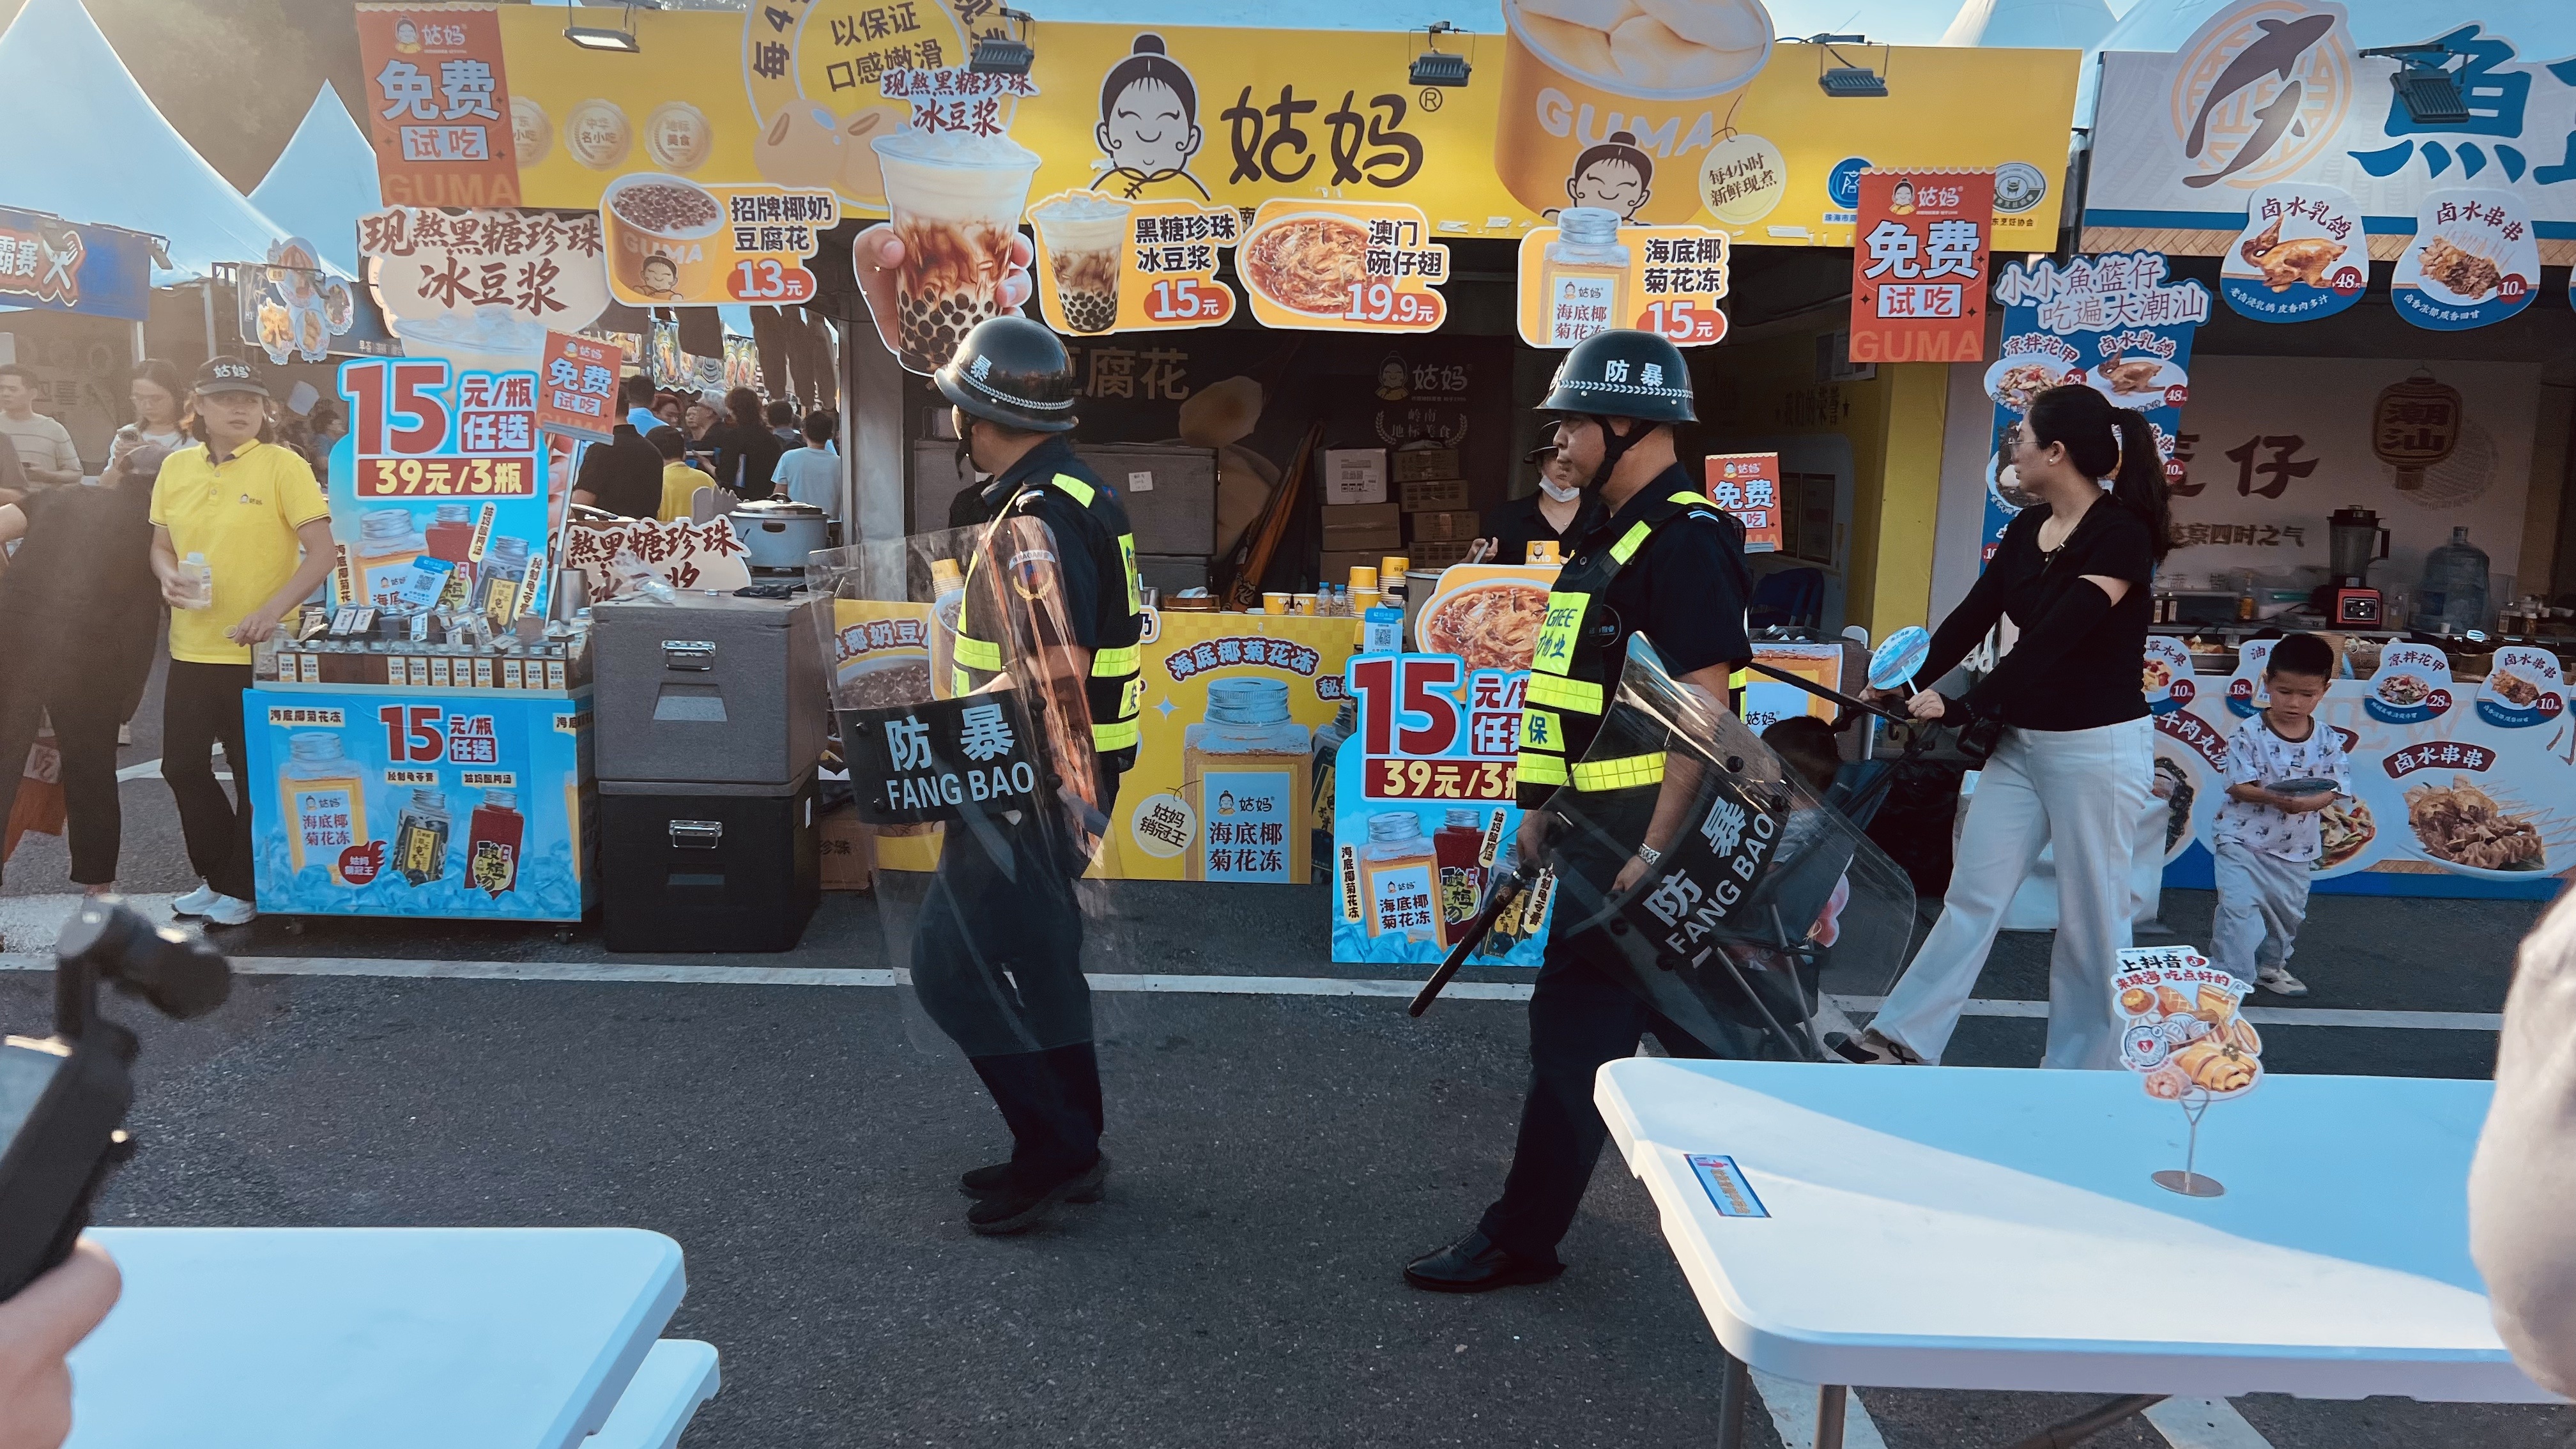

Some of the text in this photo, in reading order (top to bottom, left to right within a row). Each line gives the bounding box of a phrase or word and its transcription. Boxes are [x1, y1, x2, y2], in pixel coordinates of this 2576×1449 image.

[422, 24, 466, 45] 姑妈
[831, 4, 921, 47] 以保证
[827, 39, 942, 91] 口感嫩滑
[376, 60, 500, 121] 免费
[884, 69, 1035, 96] 现熬黑糖珍珠
[913, 98, 1005, 138] 冰豆浆
[1536, 88, 1713, 158] GUMA
[410, 129, 480, 158] 试吃
[1220, 84, 1423, 187] 姑妈
[1708, 153, 1765, 186] 每4小时
[385, 174, 520, 206] GUMA
[1710, 170, 1777, 208] 新鲜现煮
[1917, 187, 1959, 207] 姑妈
[731, 196, 831, 222] 招牌椰奶
[2261, 197, 2350, 240] 卤水乳鸽
[2437, 201, 2523, 241] 卤水串串
[363, 209, 603, 257] 现熬黑糖珍珠
[734, 226, 809, 252] 豆腐花
[1136, 213, 1236, 244] 黑糖珍珠
[1368, 220, 1418, 247] 澳门
[624, 231, 703, 264] GUMA
[1137, 245, 1212, 273] 冰豆浆
[1644, 238, 1722, 264] 海底椰
[1865, 221, 1980, 280] 免费
[1366, 249, 1443, 277] 碗仔翅
[418, 257, 571, 316] 冰豆浆
[737, 260, 802, 298] 13元
[1578, 286, 1602, 298] 姑妈
[1644, 268, 1721, 294] 菊花冻
[1153, 279, 1219, 319] 15元
[1344, 283, 1435, 323] 19.9元
[1556, 304, 1607, 322] 海底椰
[1888, 287, 1953, 316] 试吃
[2042, 287, 2206, 328] 吃遍大潮汕
[1647, 302, 1713, 340] 15元
[1852, 331, 1983, 362] GUMA
[2005, 335, 2080, 364] 凉拌花甲
[2100, 330, 2175, 359] 卤水乳鸽
[213, 364, 250, 379] 姑妈
[548, 358, 612, 399] 免费
[970, 355, 992, 383] 暴
[1413, 364, 1468, 390] 姑妈
[1606, 359, 1664, 387] 防暴
[464, 379, 532, 408] 元/瓶
[558, 392, 601, 414] 试吃
[347, 364, 447, 456] 15
[464, 415, 529, 450] 任选
[376, 460, 521, 494] 39元/3瓶
[1738, 464, 1759, 473] 姑妈
[1713, 479, 1774, 510] 免费
[548, 518, 744, 570] 熬黑糖珍珠
[1169, 640, 1317, 677] 海底椰菊花冻
[2388, 652, 2446, 671] 凉拌花甲
[2504, 653, 2557, 679] 卤水串串
[270, 709, 341, 723] 海底椰菊花冻
[1355, 661, 1457, 755] 15
[379, 706, 443, 762] 15
[450, 716, 493, 736] 元/瓶
[884, 703, 1015, 772] 防暴
[1529, 714, 1547, 744] 保
[451, 740, 495, 762] 任选
[2396, 744, 2483, 774] 卤水串串
[887, 762, 1034, 810] FANG BAO
[1152, 803, 1186, 826] 姑妈
[1239, 797, 1272, 813] 姑妈
[303, 814, 348, 829] 海底椰
[1139, 817, 1187, 848] 销冠王
[1209, 822, 1282, 846] 海底椰
[304, 831, 351, 846] 菊花冻
[1209, 848, 1282, 873] 菊花冻
[1643, 796, 1747, 928] 防暴
[1342, 847, 1360, 918] 海底椰菊花冻
[1398, 881, 1414, 890] 姑妈
[1666, 813, 1775, 954] FANG BAO
[1380, 893, 1429, 914] 海底椰
[1381, 910, 1431, 930] 菊花冻
[2122, 954, 2181, 973] 上抖音
[2116, 970, 2230, 990] 来珠海 吃点好的
